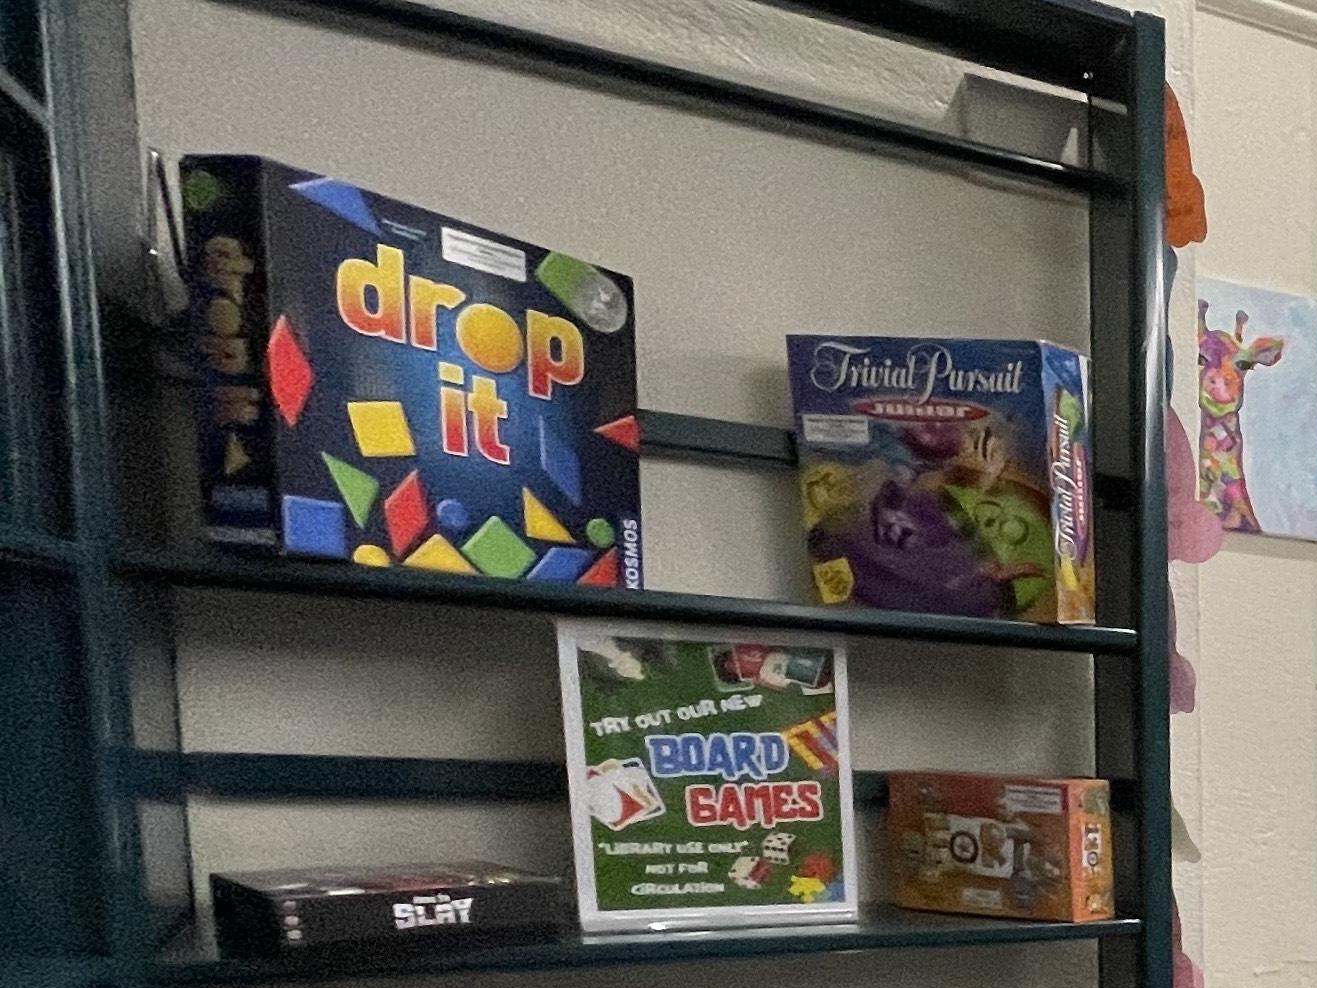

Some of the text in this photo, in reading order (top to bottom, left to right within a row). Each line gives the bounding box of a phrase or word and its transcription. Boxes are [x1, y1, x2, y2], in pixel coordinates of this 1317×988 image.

[335, 243, 585, 400] drop
[810, 341, 1025, 405] Trivial Pursuit
[437, 360, 511, 465] it
[1050, 413, 1080, 493] Pursuit
[1053, 488, 1079, 562] Trivial
[623, 519, 640, 590] KOSMOS
[590, 694, 764, 737] TRY OUT OUR NEW
[645, 732, 790, 780] BOARD
[685, 781, 824, 831] GAMES
[645, 861, 709, 875] NOT FOR
[676, 841, 705, 855] USE
[392, 897, 474, 930] SLAY
[630, 882, 725, 896] CIRCULATION
